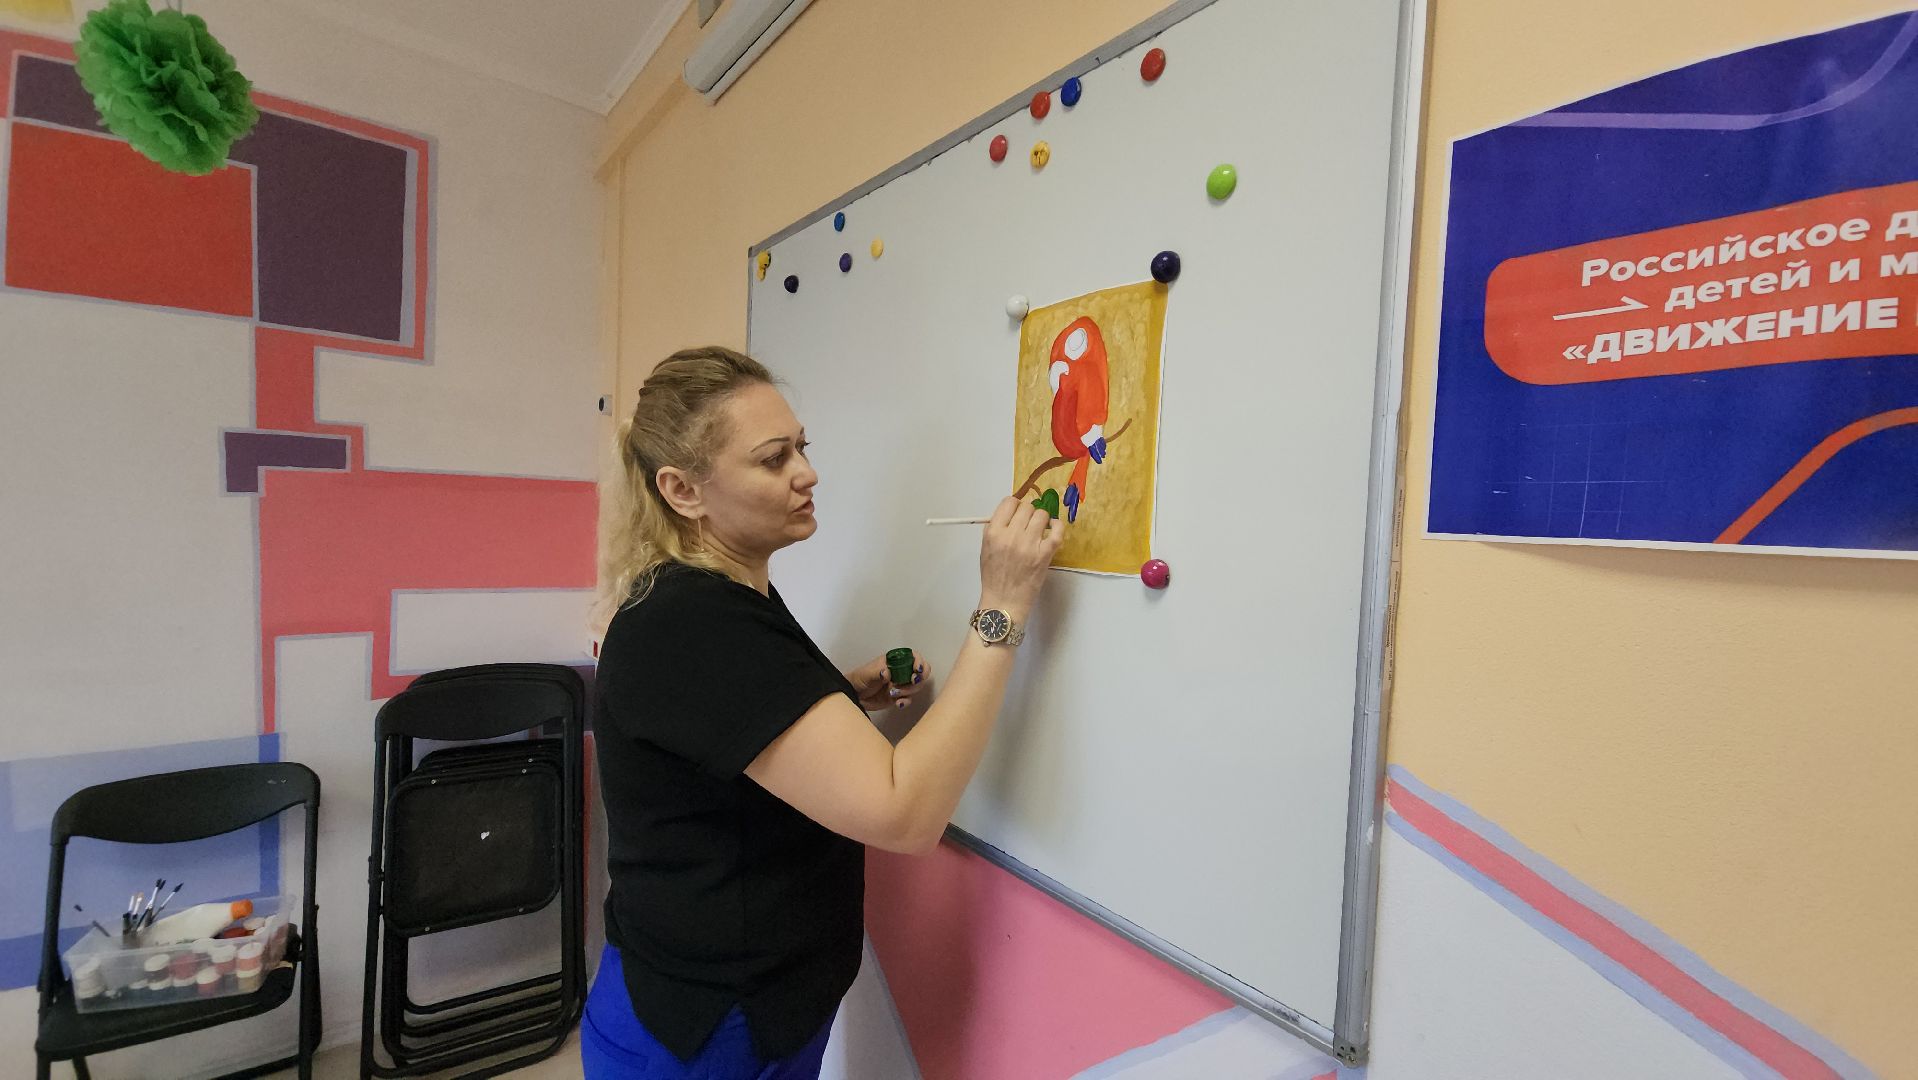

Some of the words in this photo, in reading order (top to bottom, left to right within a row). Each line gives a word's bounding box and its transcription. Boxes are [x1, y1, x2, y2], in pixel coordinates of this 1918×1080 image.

[1581, 218, 1871, 287] Российское
[1664, 259, 1812, 313] детей
[1829, 258, 1860, 283] и
[1562, 297, 1898, 365] «ДВИЖЕНИЕ
